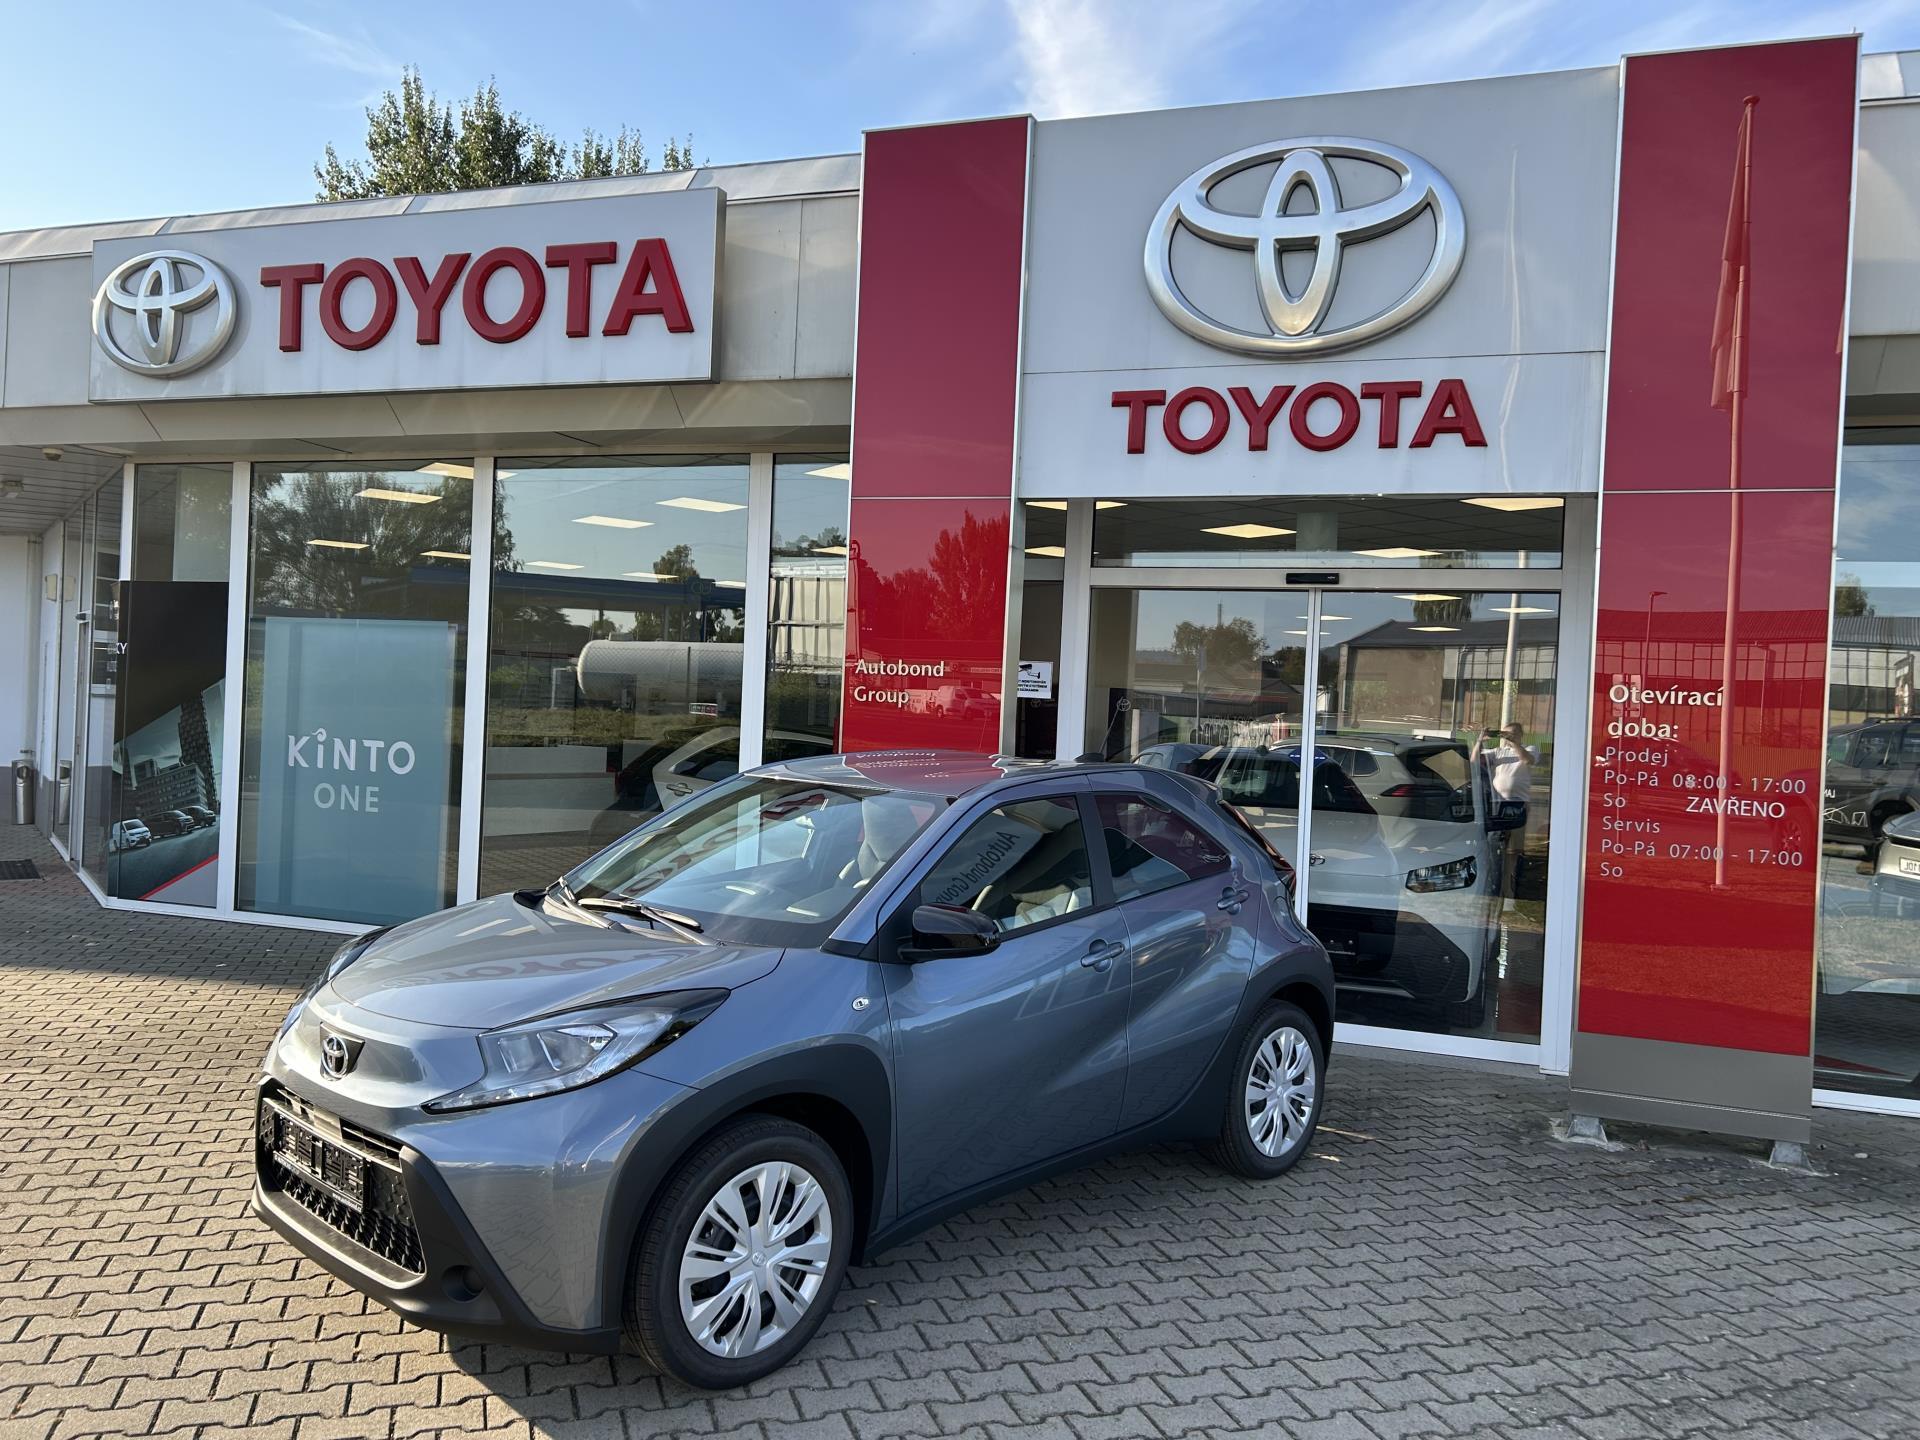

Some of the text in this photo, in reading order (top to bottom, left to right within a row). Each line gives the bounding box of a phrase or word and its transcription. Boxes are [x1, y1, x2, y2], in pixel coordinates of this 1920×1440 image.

[260, 238, 695, 352] TOYOTA
[1111, 379, 1489, 455] TOYOTA
[855, 659, 945, 677] Autobond
[853, 686, 910, 708] Group
[1609, 684, 1725, 707] Otevírací
[1607, 716, 1679, 739] doba:
[1605, 746, 1669, 767] Prodej
[1603, 770, 1659, 787] Po-Pá
[1672, 773, 1727, 790] 08:00
[1751, 777, 1807, 795] 17:00
[313, 782, 380, 813] ONE
[1603, 792, 1786, 819] So ZAVŘENO
[1601, 815, 1661, 834] Servis
[1600, 839, 1656, 857] Po-Pá
[1669, 843, 1725, 861] 07:00
[1747, 848, 1804, 867] 17:00
[1599, 861, 1624, 878] So
